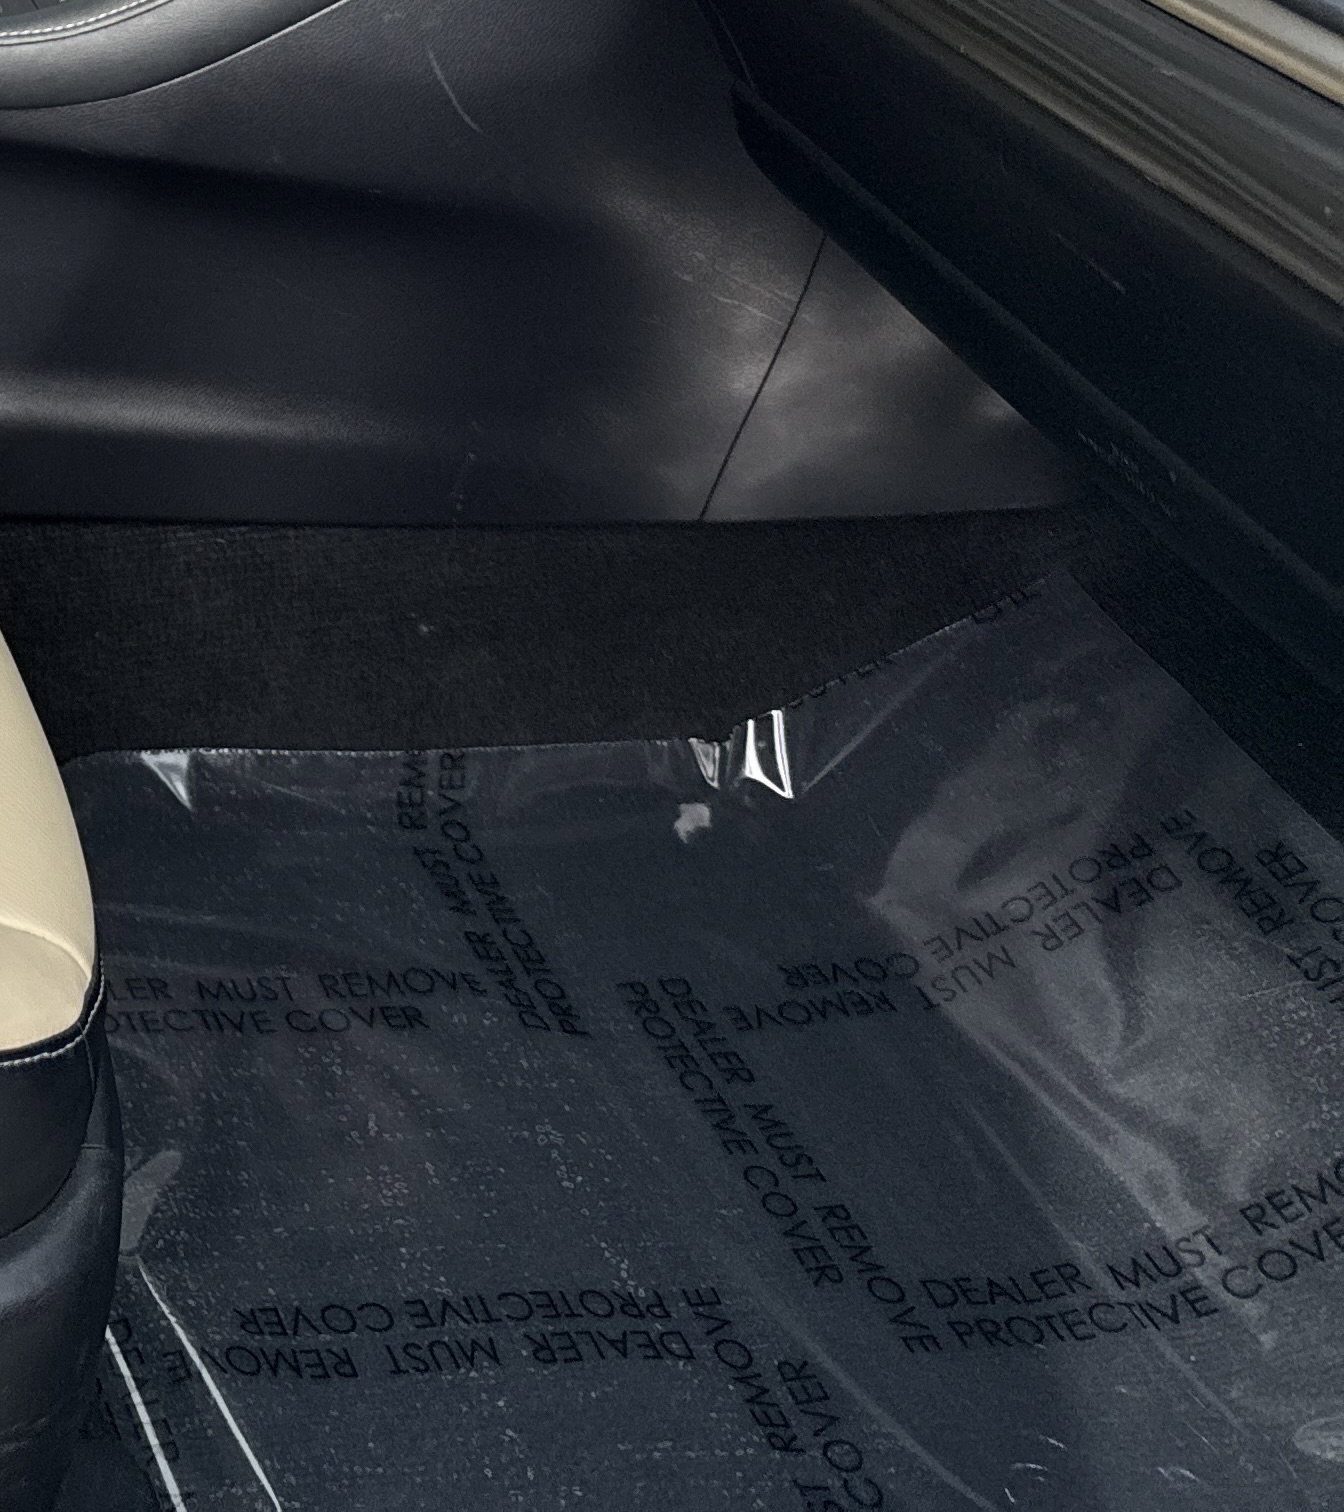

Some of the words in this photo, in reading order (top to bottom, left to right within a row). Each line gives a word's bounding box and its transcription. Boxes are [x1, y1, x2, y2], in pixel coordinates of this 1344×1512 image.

[438, 751, 484, 866] COVER
[923, 831, 1156, 965] PROTECTIVE
[1161, 808, 1295, 937] REMOVE
[1031, 863, 1184, 953] DEALER
[195, 976, 298, 1003] MUST
[316, 967, 489, 1002] REMOVE
[776, 951, 921, 989] COVER
[916, 944, 1018, 1013] MUST
[284, 1005, 431, 1034] COVER
[721, 989, 899, 1032] REMOVE
[616, 979, 760, 1156] PROTECTIVE
[742, 1164, 845, 1288] COVER
[657, 977, 756, 1084] DEALER
[740, 1102, 828, 1183] MUST
[813, 1203, 943, 1353] REMOVE
[920, 1261, 1093, 1310] DEALER
[1106, 1225, 1224, 1292] MUST
[232, 1301, 396, 1338] COVER
[402, 1288, 673, 1331] PROTECTIVE
[947, 1280, 1220, 1350] PROTECTIVE
[384, 1336, 503, 1376] MUST
[522, 1329, 698, 1366] DEALER
[681, 1287, 807, 1454] REMOVE
[776, 1360, 885, 1510] COVER
